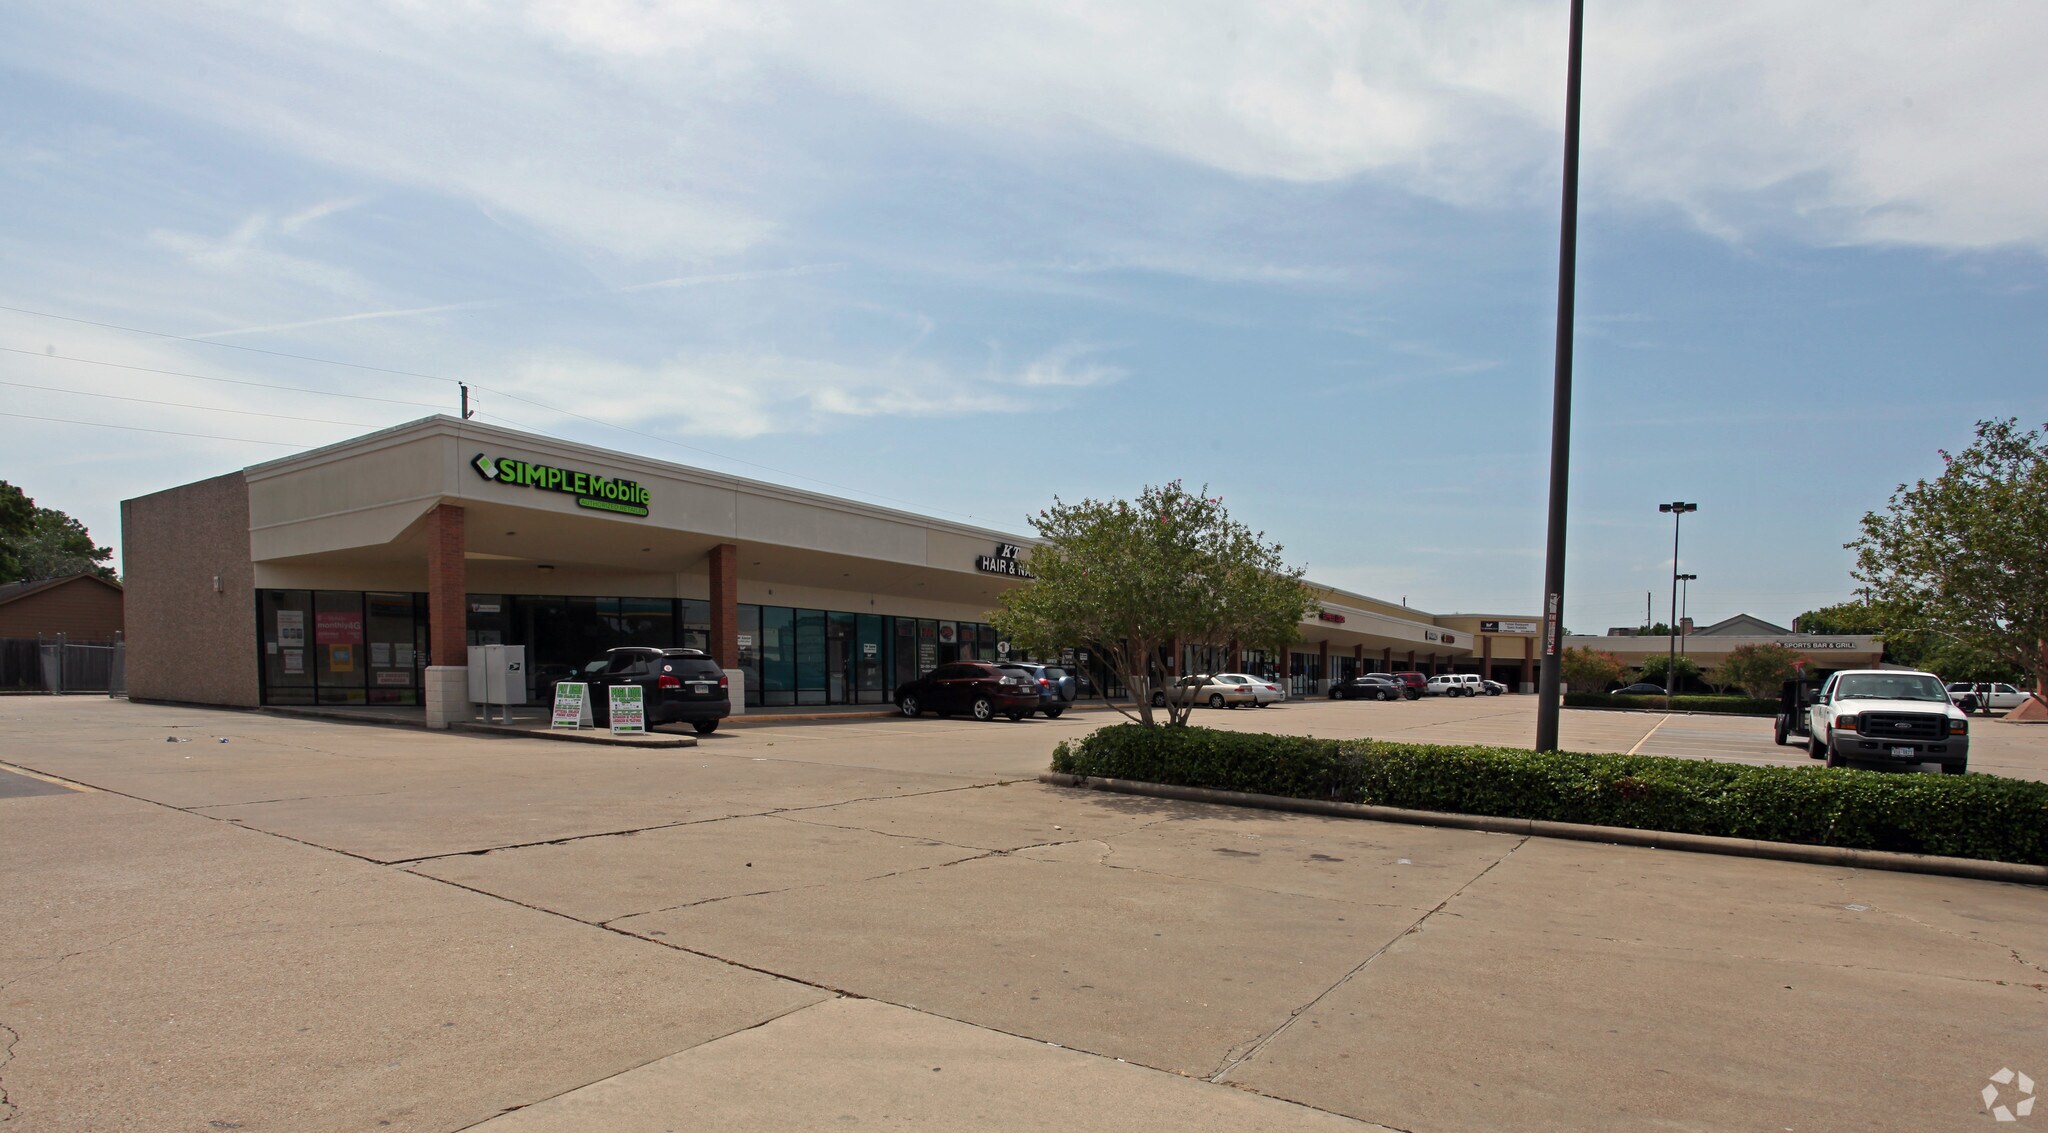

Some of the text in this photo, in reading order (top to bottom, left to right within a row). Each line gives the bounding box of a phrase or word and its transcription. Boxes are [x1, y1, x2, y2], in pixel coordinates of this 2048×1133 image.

[499, 459, 587, 494] SIMPLE
[1001, 544, 1021, 559] KT
[982, 556, 1007, 574] HAIR
[1009, 561, 1016, 575] &
